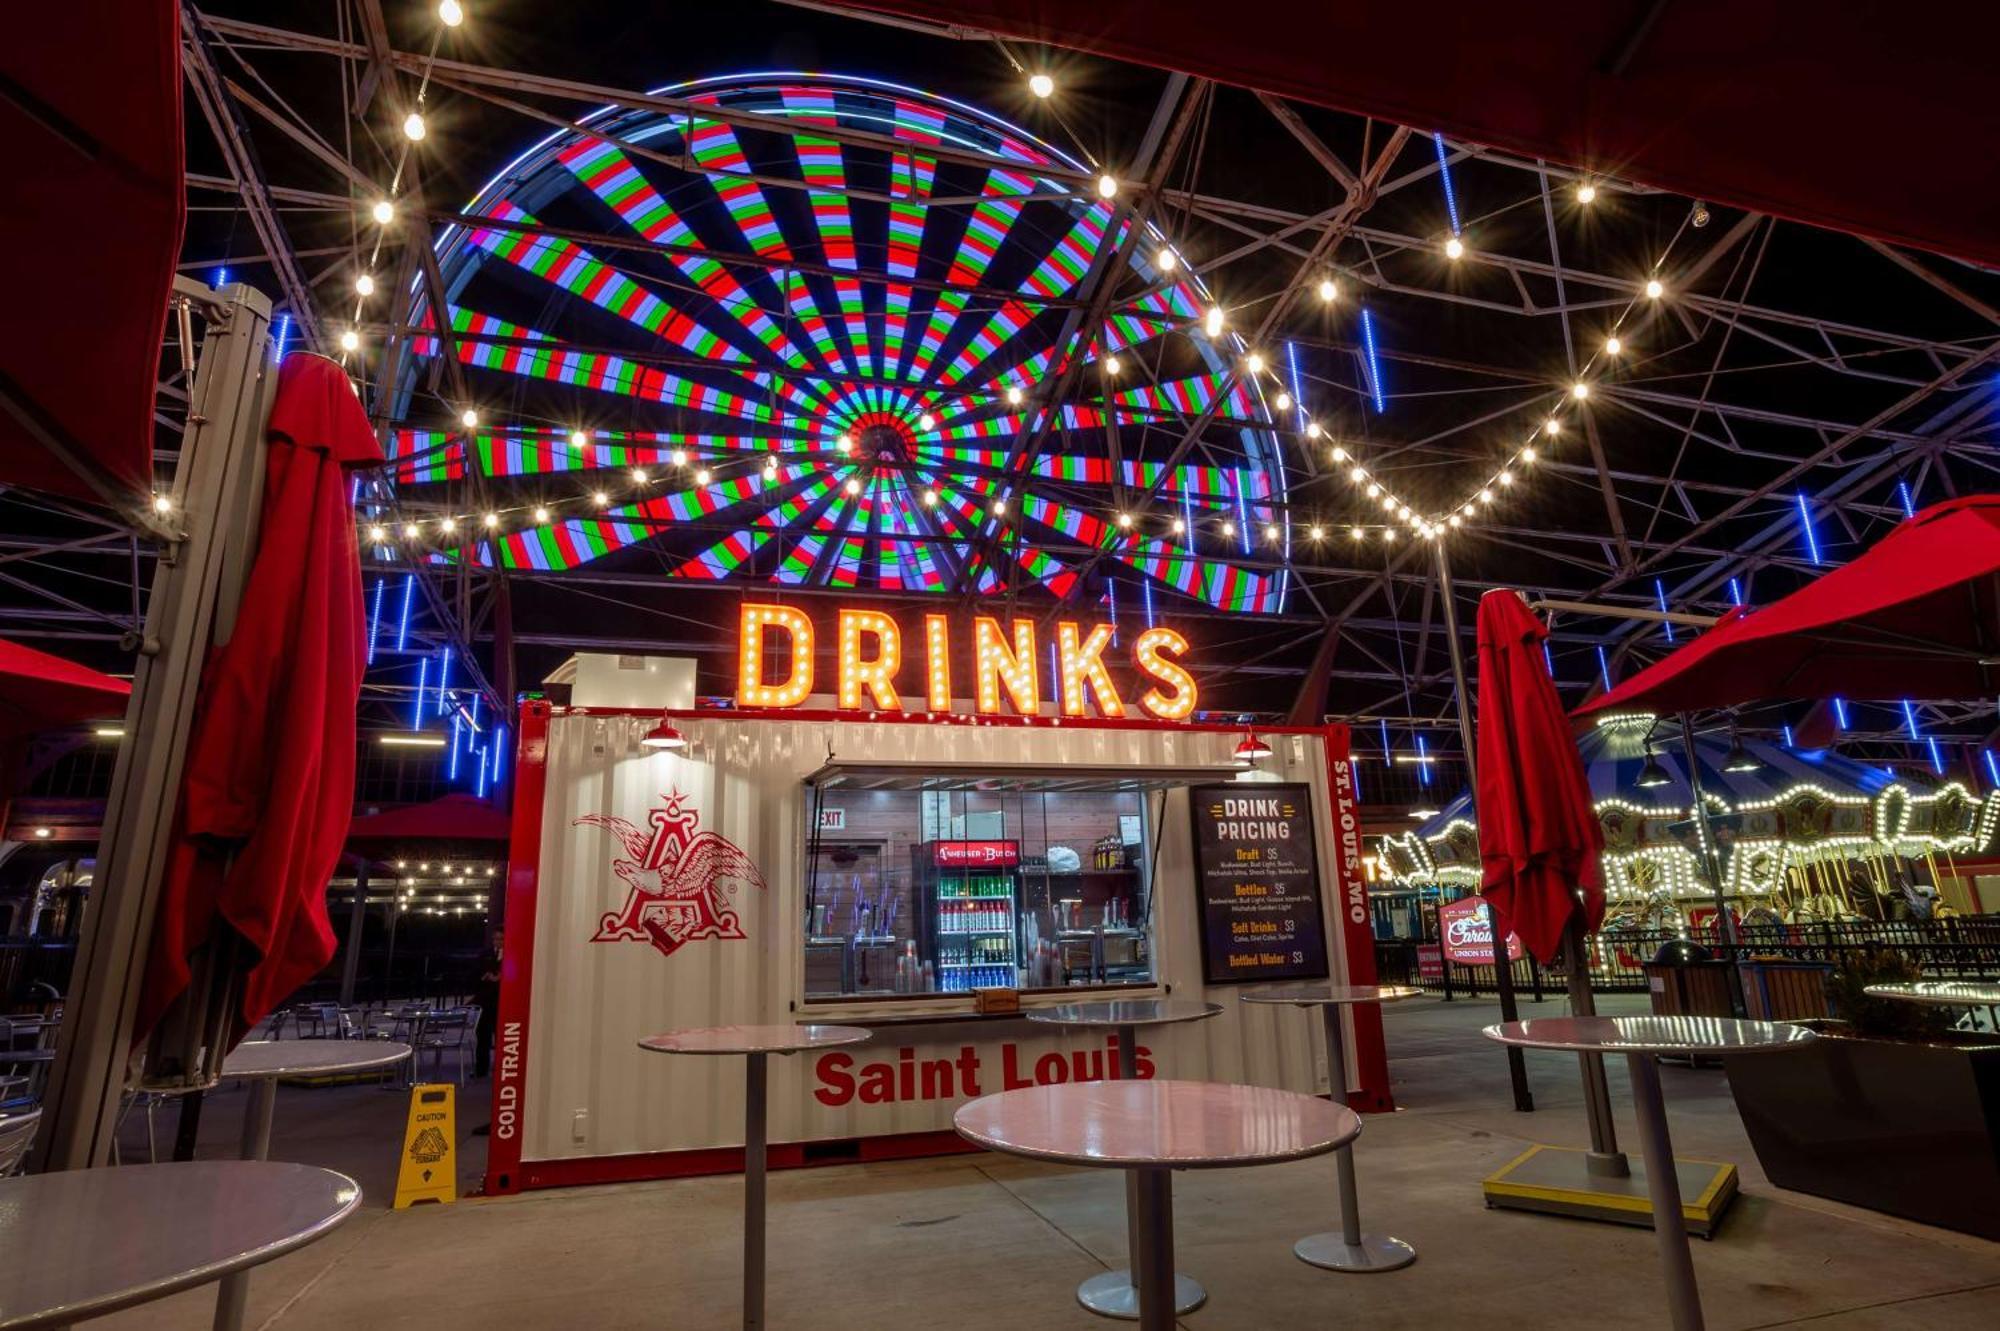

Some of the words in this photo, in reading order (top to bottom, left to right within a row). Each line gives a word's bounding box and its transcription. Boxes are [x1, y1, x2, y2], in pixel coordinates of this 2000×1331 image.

[738, 603, 1198, 719] DRINKS
[1334, 760, 1350, 795] ST.
[1224, 799, 1279, 817] DRINK
[820, 811, 841, 826] EXIT
[1217, 821, 1290, 840] PRICING
[1338, 798, 1359, 877] LOUIS,
[1236, 848, 1260, 860] Draft
[1235, 884, 1268, 897] Bottles
[1274, 883, 1286, 896] $5
[1348, 881, 1365, 923] MO
[1231, 922, 1250, 934] Soft
[1250, 920, 1278, 933] Drinks
[1284, 919, 1296, 932] $3
[1229, 953, 1259, 968] Bottled
[1260, 952, 1286, 965] Water
[1292, 950, 1305, 964] $3
[501, 1022, 521, 1082] TRAIN
[813, 1046, 982, 1107] Saint
[1002, 1034, 1156, 1092] Louis
[416, 1111, 447, 1122] CAUTION
[497, 1085, 517, 1139] COLD
